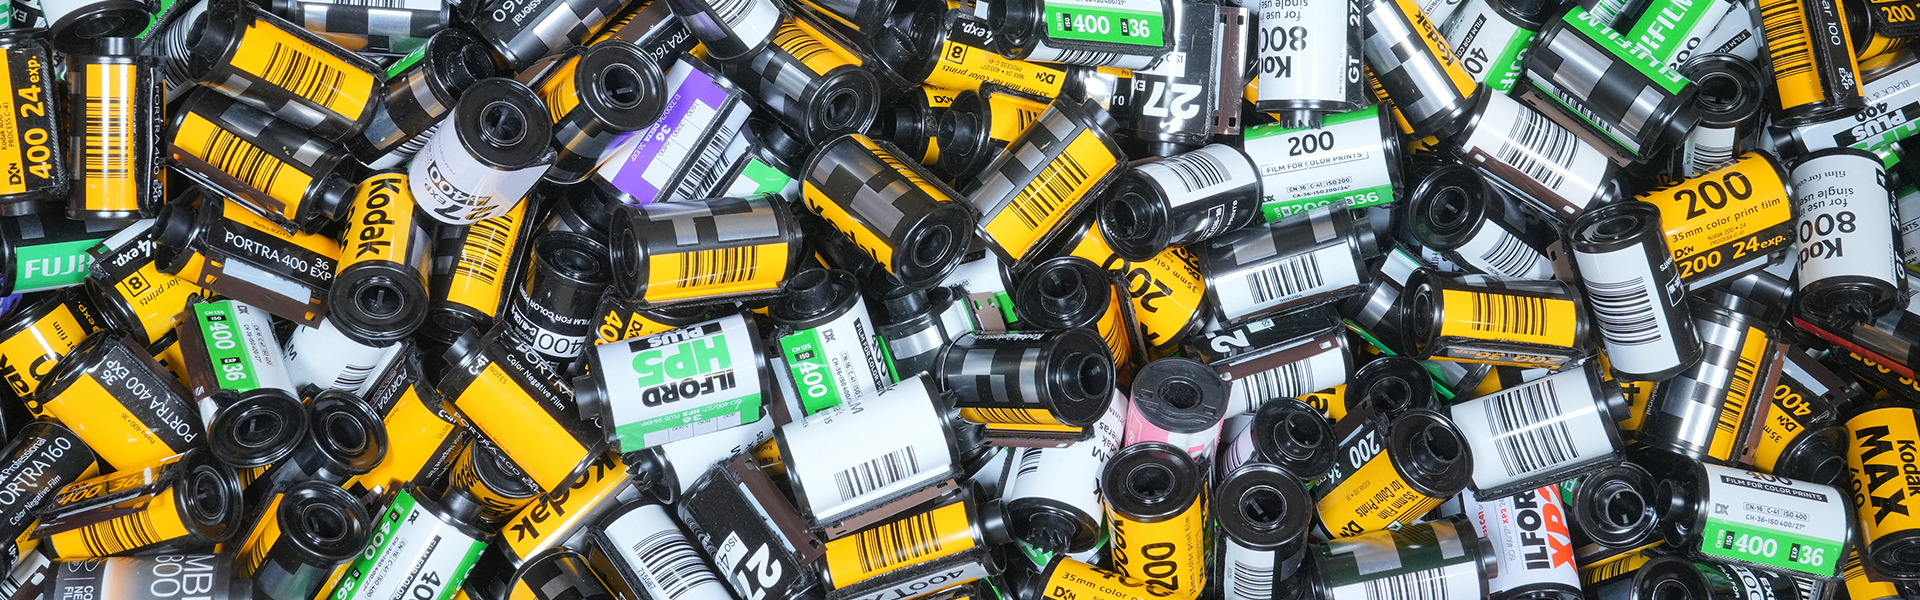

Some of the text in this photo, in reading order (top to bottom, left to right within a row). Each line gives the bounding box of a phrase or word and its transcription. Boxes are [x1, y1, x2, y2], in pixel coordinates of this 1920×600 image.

[1074, 14, 1110, 34] 400
[1265, 11, 1301, 21] for use
[1881, 5, 1916, 23] 200
[1129, 19, 1150, 37] 36
[1415, 9, 1455, 67] Kodak
[1465, 18, 1484, 46] FILM FOR
[1828, 21, 1841, 46] 100
[951, 46, 963, 58] 8
[1577, 11, 1684, 83] FUJIFILM
[1730, 33, 1747, 48] FILM
[942, 64, 989, 82] color prints
[998, 61, 1023, 72] PROCESS
[1348, 55, 1360, 84] GT
[1838, 67, 1849, 90] EXP
[1845, 71, 1854, 86] 36
[1882, 79, 1911, 96] BLACK
[1143, 81, 1202, 120] 27
[1855, 102, 1888, 122] 400
[152, 85, 163, 175] PORTRA 400
[644, 121, 660, 143] DELTA
[672, 102, 699, 138] 1600 3200
[1851, 108, 1906, 141] PLUS
[655, 124, 672, 142] 36
[1288, 131, 1335, 156] 200
[24, 127, 52, 179] 400
[1266, 152, 1363, 174] FILM FOR COLOR PRINTS
[428, 163, 470, 204] 400
[1288, 181, 1323, 193] CN-16 C-41
[1809, 170, 1846, 182] film for
[1355, 191, 1379, 204] 36
[1674, 171, 1753, 221] 200
[1799, 187, 1854, 205] single use
[1807, 197, 1848, 212] for use
[357, 178, 401, 259] Kodak
[1672, 197, 1781, 243] 35mm color print film
[1800, 211, 1856, 244] 800
[1707, 233, 1723, 241] Kodak
[1710, 230, 1746, 247] PROCESS C-41
[225, 231, 307, 272] PORTRA 400
[310, 266, 332, 281] EXP
[316, 258, 329, 270] 36
[1679, 251, 1722, 279] 200
[1895, 250, 1906, 280] GT
[128, 277, 143, 290] 8
[1101, 253, 1173, 313] 200
[1173, 271, 1198, 293] 35mm
[139, 286, 165, 307] prints
[529, 297, 573, 325] FOR COLOR
[209, 322, 236, 350] 400
[538, 333, 583, 356] 400
[647, 326, 703, 348] PLUS
[632, 334, 732, 388] HP5
[855, 323, 880, 380] FILM FOR COLOR
[1512, 354, 1562, 366] 200
[106, 360, 130, 381] EXP
[222, 364, 247, 381] 36
[468, 356, 489, 375] C-41
[489, 365, 508, 385] NOTES
[517, 343, 576, 402] PORTRA
[840, 352, 856, 384] CN-16 C-41
[100, 370, 114, 387] 36
[506, 354, 565, 411] Color Negative Film
[641, 368, 737, 407] ILFORD
[799, 362, 827, 398] 400
[125, 374, 198, 443] PORTRA 400
[1774, 384, 1812, 417] 400
[682, 414, 702, 423] 36
[437, 425, 451, 440] NOTES
[453, 411, 498, 455] PORTRA
[498, 453, 521, 476] 400
[3, 435, 47, 478] Professional
[1349, 430, 1380, 469] 200
[0, 436, 72, 513] ORTRA 160
[1855, 425, 1910, 528] MAX
[1896, 439, 1920, 497] Kodak
[9, 508, 27, 526] Color
[24, 485, 51, 511] Negative
[48, 475, 62, 489] Film
[509, 452, 617, 543] Kodak
[1354, 479, 1405, 518] for Color Prints
[1726, 478, 1823, 501] FILM FOR COLOR PRINTS
[1377, 490, 1419, 521] 35mm Film
[1500, 508, 1509, 524] XP2
[1715, 503, 1730, 516] DX
[1745, 503, 1808, 521] CN-16 C-41 ISO 400
[365, 519, 392, 559] 400
[1514, 489, 1550, 569] ILFOR
[1725, 535, 1733, 547] ISO
[725, 535, 738, 552] ISO
[1735, 534, 1778, 558] 400
[1791, 547, 1799, 560] EXP
[1799, 545, 1824, 567] 36
[1141, 542, 1179, 597] 200
[336, 576, 355, 600] 36
[1062, 572, 1096, 588] 35mm
[1100, 585, 1127, 598] color
